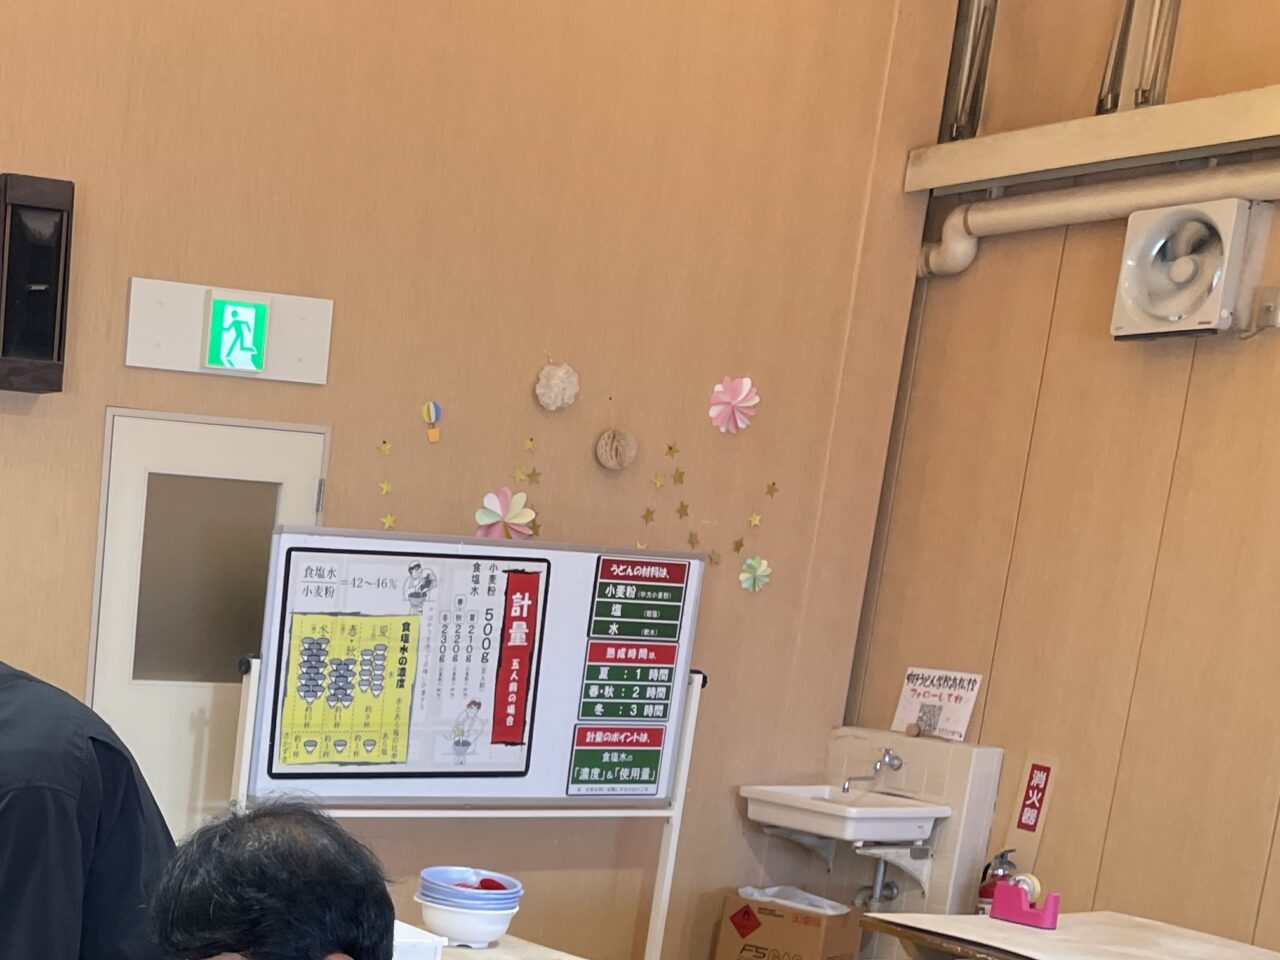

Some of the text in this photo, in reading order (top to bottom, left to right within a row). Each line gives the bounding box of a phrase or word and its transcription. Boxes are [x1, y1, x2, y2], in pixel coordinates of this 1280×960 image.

[304, 565, 337, 580] 食塩水
[470, 562, 481, 596] 食塩水
[487, 563, 498, 597] 小麦粉
[302, 585, 336, 599] 小麦粉
[605, 584, 637, 599] 小麦粉
[507, 592, 533, 647] 計量
[608, 622, 619, 636] 水
[1021, 769, 1048, 826] 消火器
